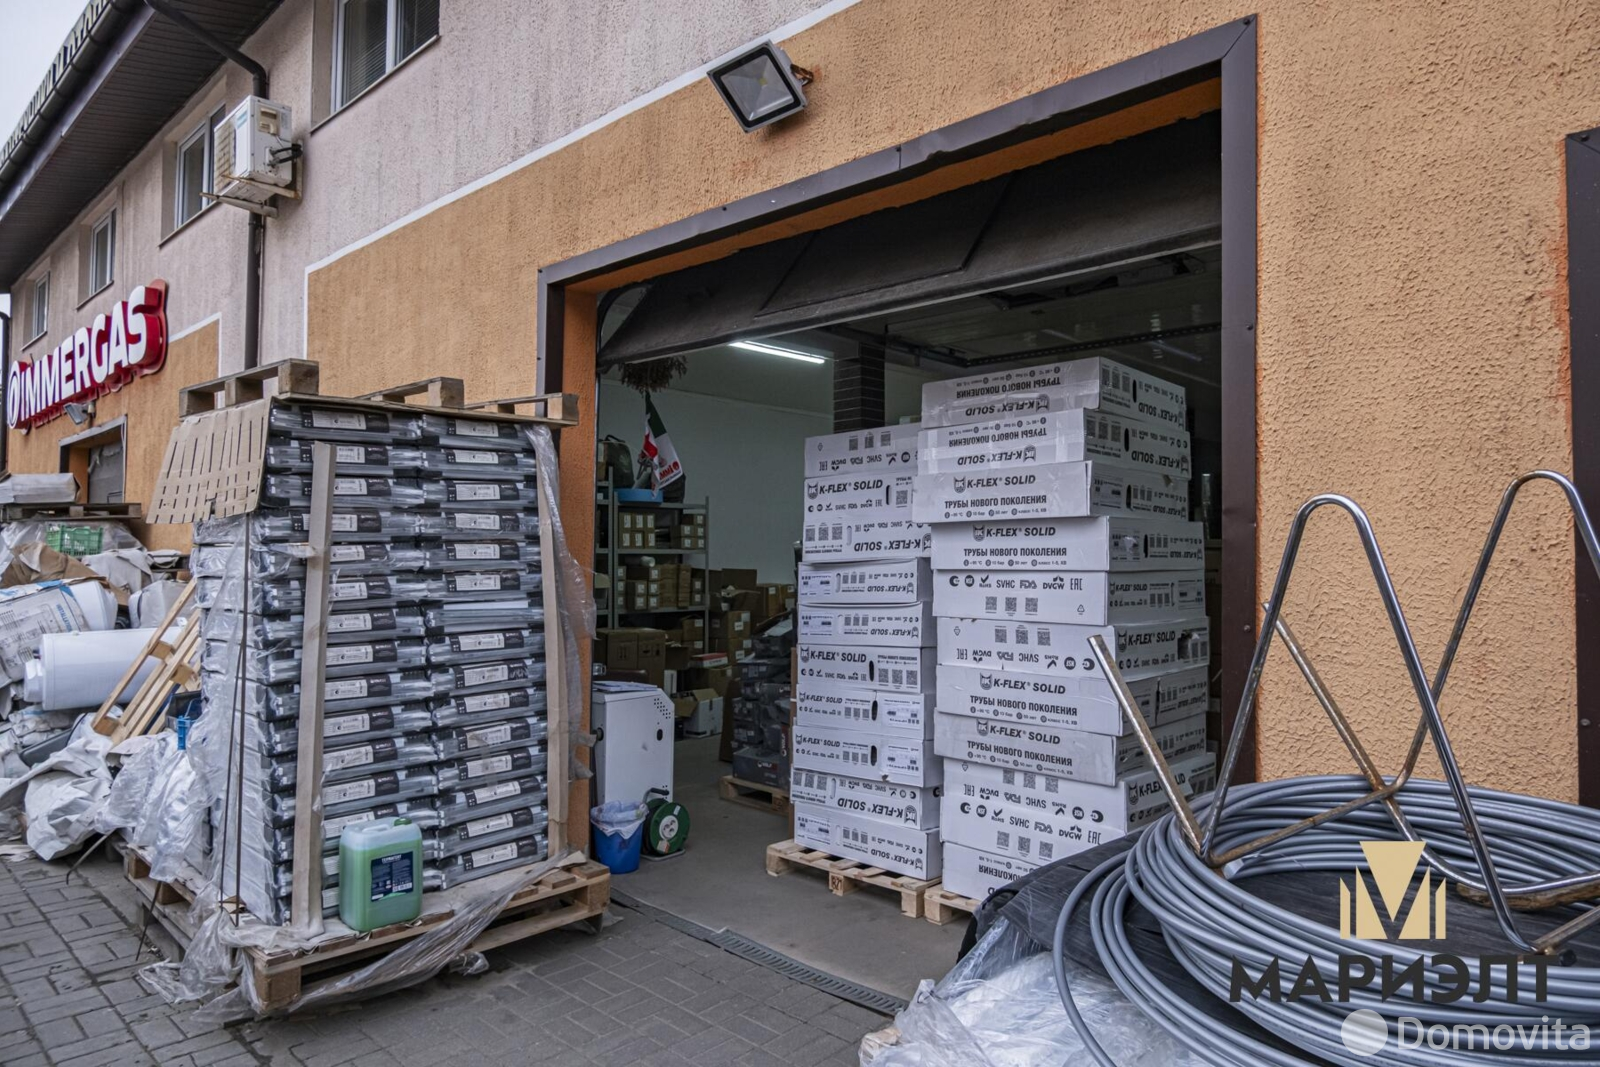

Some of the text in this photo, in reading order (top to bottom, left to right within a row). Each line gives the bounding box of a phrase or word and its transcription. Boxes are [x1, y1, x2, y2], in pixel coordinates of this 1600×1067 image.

[21, 285, 147, 421] IMMERGAS
[1002, 380, 1031, 392] НОВОГО
[1034, 377, 1060, 388] ТРУБЫ
[957, 384, 999, 398] ПОКОЛЕНИЯ
[966, 406, 995, 416] SOLID
[1139, 402, 1156, 416] SOLID
[991, 431, 1019, 443] НОВОГО
[1021, 428, 1046, 439] ТРУБЫ
[949, 435, 989, 447] ПОКОЛЕНИЯ
[867, 455, 882, 463] SVHC
[958, 455, 985, 465] SOLID
[1132, 450, 1154, 463] SOLID
[853, 480, 883, 491] SOLID
[1005, 475, 1036, 486] SOLID
[945, 495, 1046, 509] ТРУБЫ НОВОГО ПОКОЛЕНИЯ
[1024, 527, 1056, 536] SOLID
[854, 541, 882, 552] SOLID
[1020, 548, 1067, 556] ПОКОЛЕНИЯ
[997, 580, 1015, 589] SVHC
[1020, 580, 1037, 589] FDA
[1157, 631, 1175, 643] SOLID
[841, 653, 866, 663] SOLID
[997, 651, 1013, 661] FDA
[1019, 653, 1039, 663] SVHC
[1033, 682, 1066, 694] SOLID
[970, 695, 1077, 716] ТРУБЫ НОВОГО ПОКОЛЕНИЯ
[1028, 732, 1060, 745] SOLID
[967, 740, 1072, 766] ТРУБЫ НОВОГО ПОКОЛЕНИЯ
[980, 787, 999, 797] DVGW
[1004, 792, 1021, 804] FDA
[1026, 797, 1046, 808] SVHC
[838, 798, 866, 810] SOLID
[1010, 816, 1029, 829] SVHC
[1034, 821, 1053, 834] FDA
[1059, 830, 1082, 840] DVGW
[871, 849, 890, 859] SOLID
